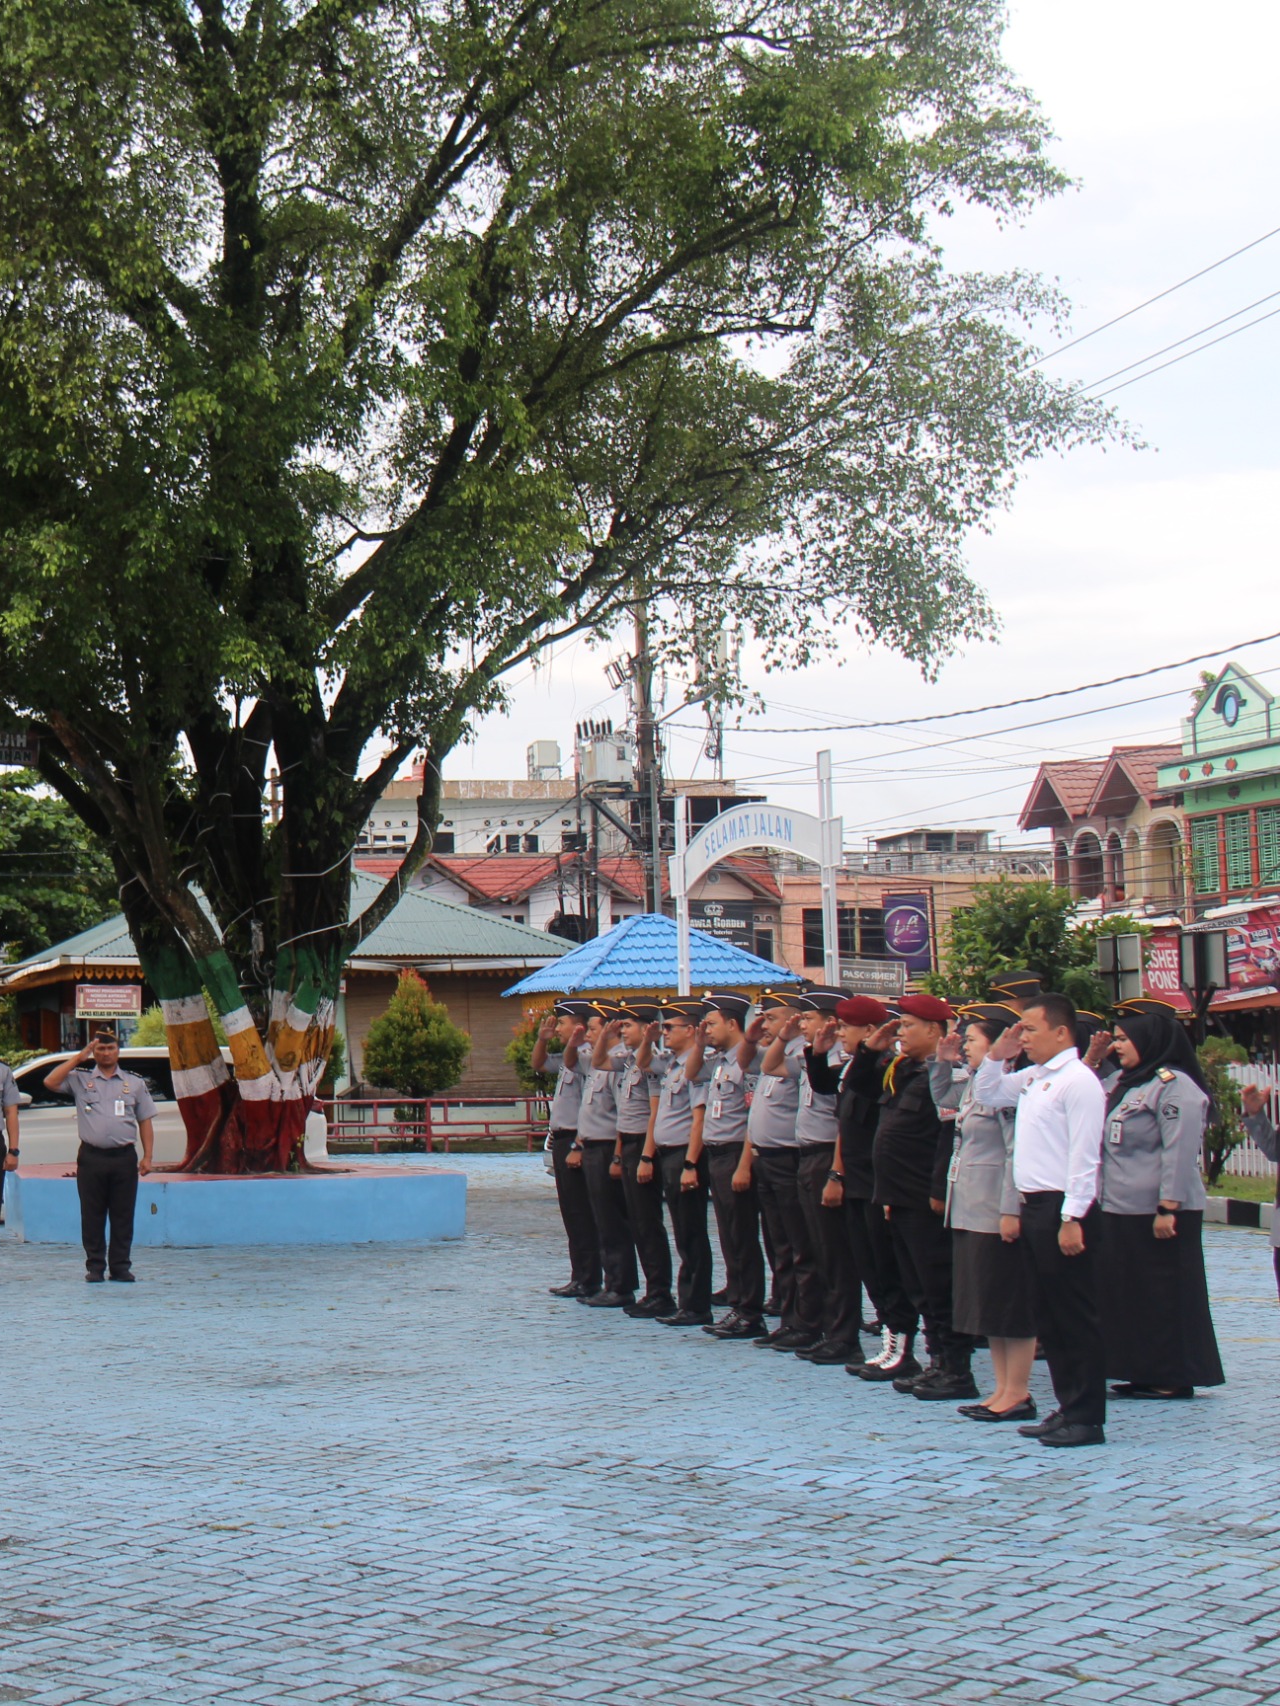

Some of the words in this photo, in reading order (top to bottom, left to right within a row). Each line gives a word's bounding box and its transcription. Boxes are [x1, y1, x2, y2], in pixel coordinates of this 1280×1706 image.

[704, 815, 750, 860] SELAMAT
[753, 813, 792, 842] JALAN
[713, 916, 746, 929] GORDEN
